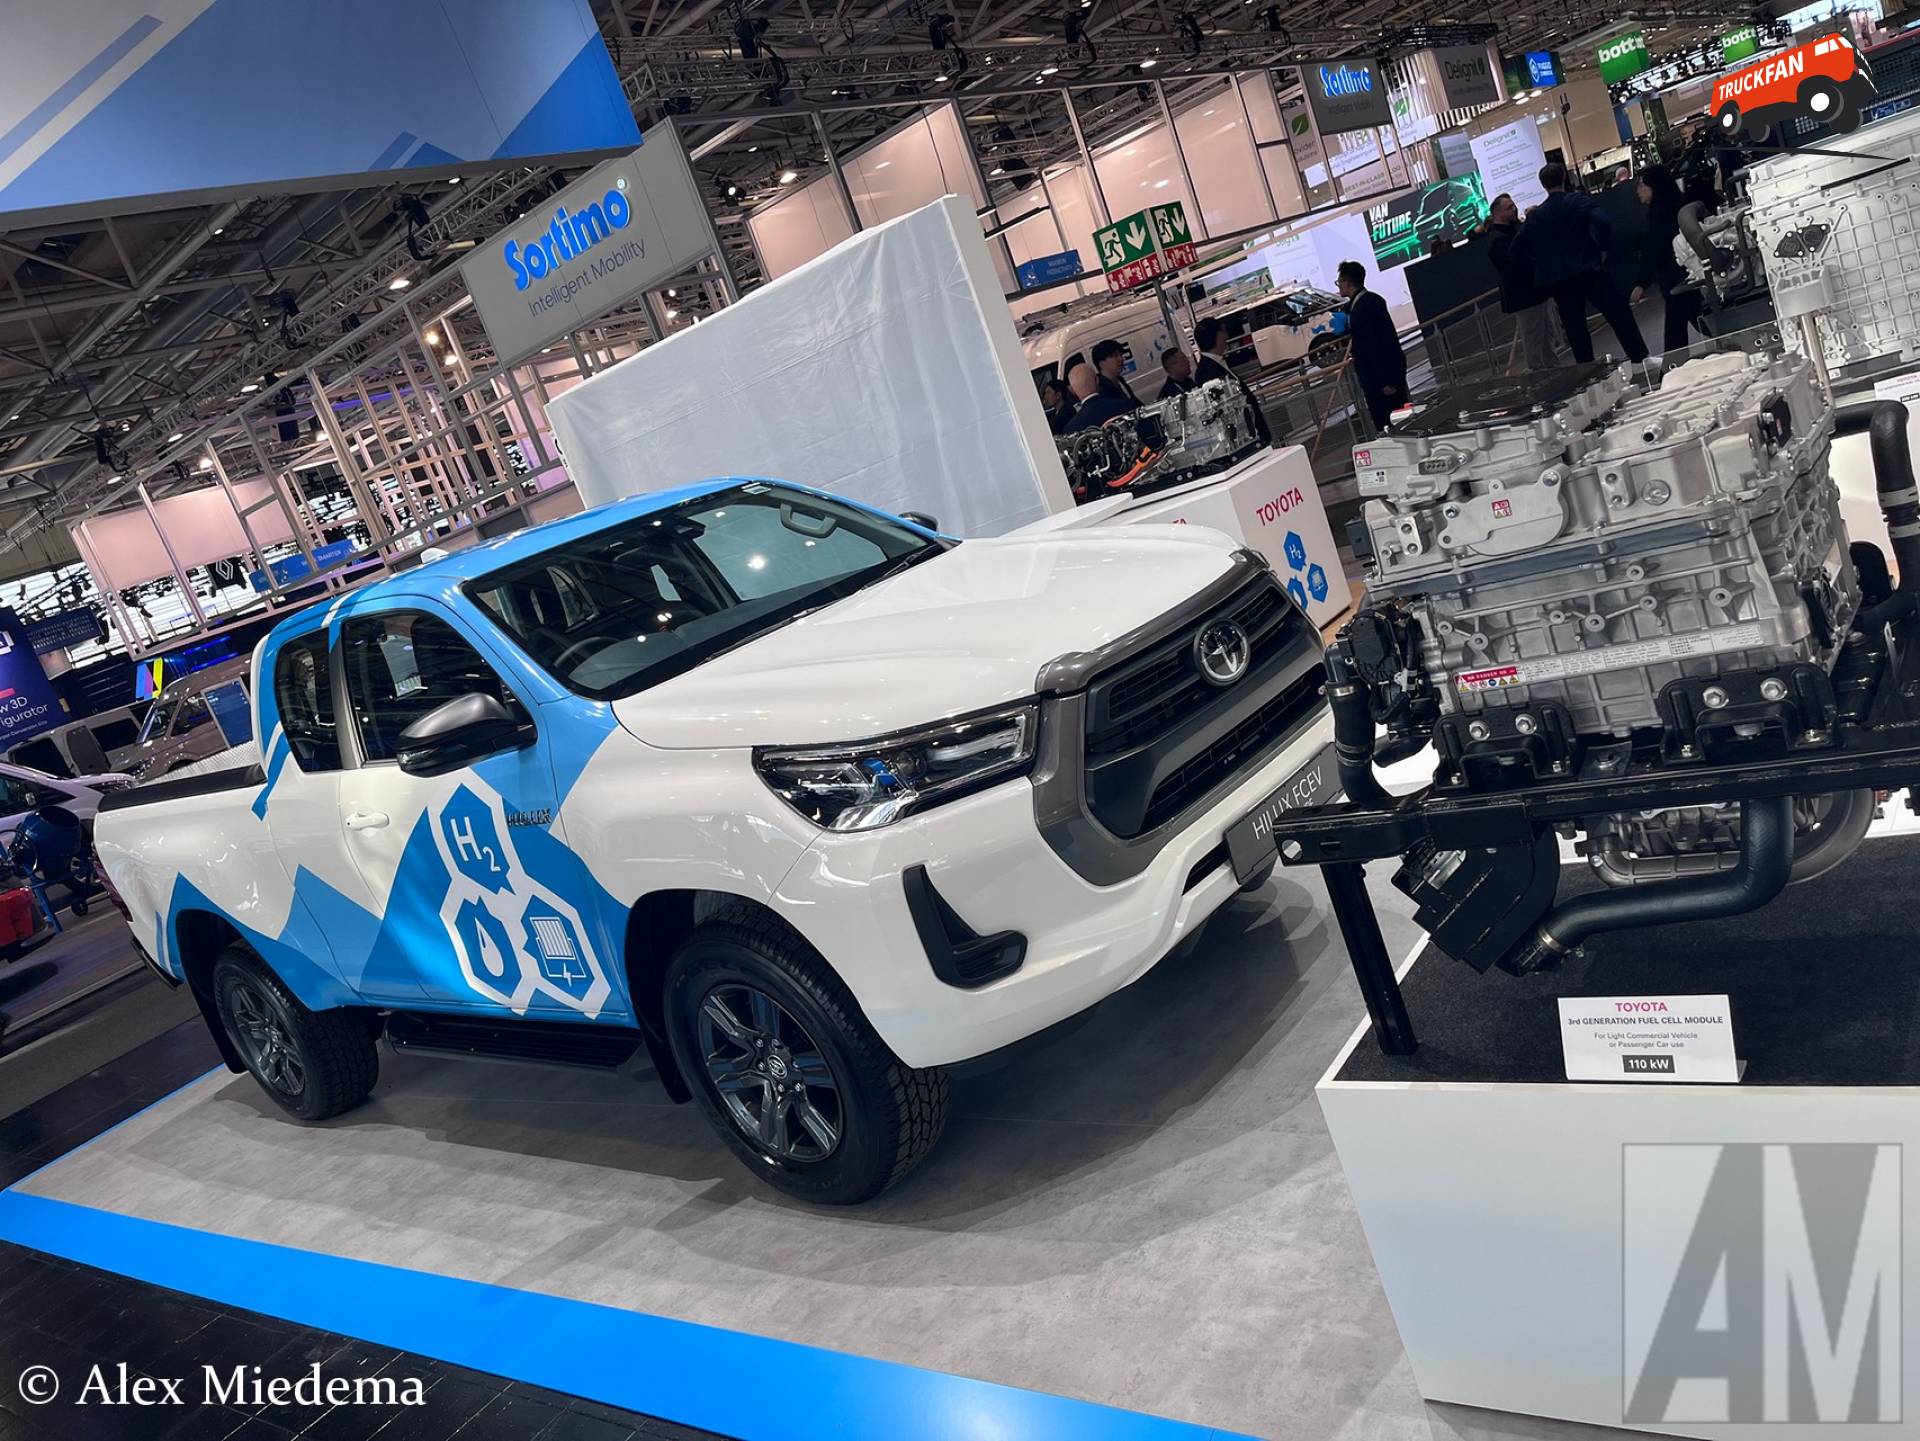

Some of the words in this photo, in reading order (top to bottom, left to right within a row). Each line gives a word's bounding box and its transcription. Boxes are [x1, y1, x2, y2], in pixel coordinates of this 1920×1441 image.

[1369, 202, 1389, 222] VAN
[1372, 211, 1412, 241] FUTURE
[504, 188, 630, 292] Sortimo
[528, 271, 592, 317] Intelligent
[590, 239, 646, 279] Mobility
[1256, 487, 1304, 526] TOYOTA
[10, 697, 28, 709] 3D
[0, 705, 48, 728] igurator
[1292, 766, 1322, 805] FCEV
[1615, 1002, 1668, 1013] TOYOTA
[1568, 1018, 1581, 1026] 3rd
[1582, 1017, 1636, 1025] GENERATION
[1638, 1017, 1660, 1025] FUEL
[1661, 1016, 1682, 1025] CELL
[1684, 1016, 1723, 1024] MODULE
[1607, 1032, 1625, 1041] Light
[1618, 1041, 1654, 1050] Passenger
[1629, 1059, 1647, 1069] 110
[1650, 1059, 1669, 1069] kW
